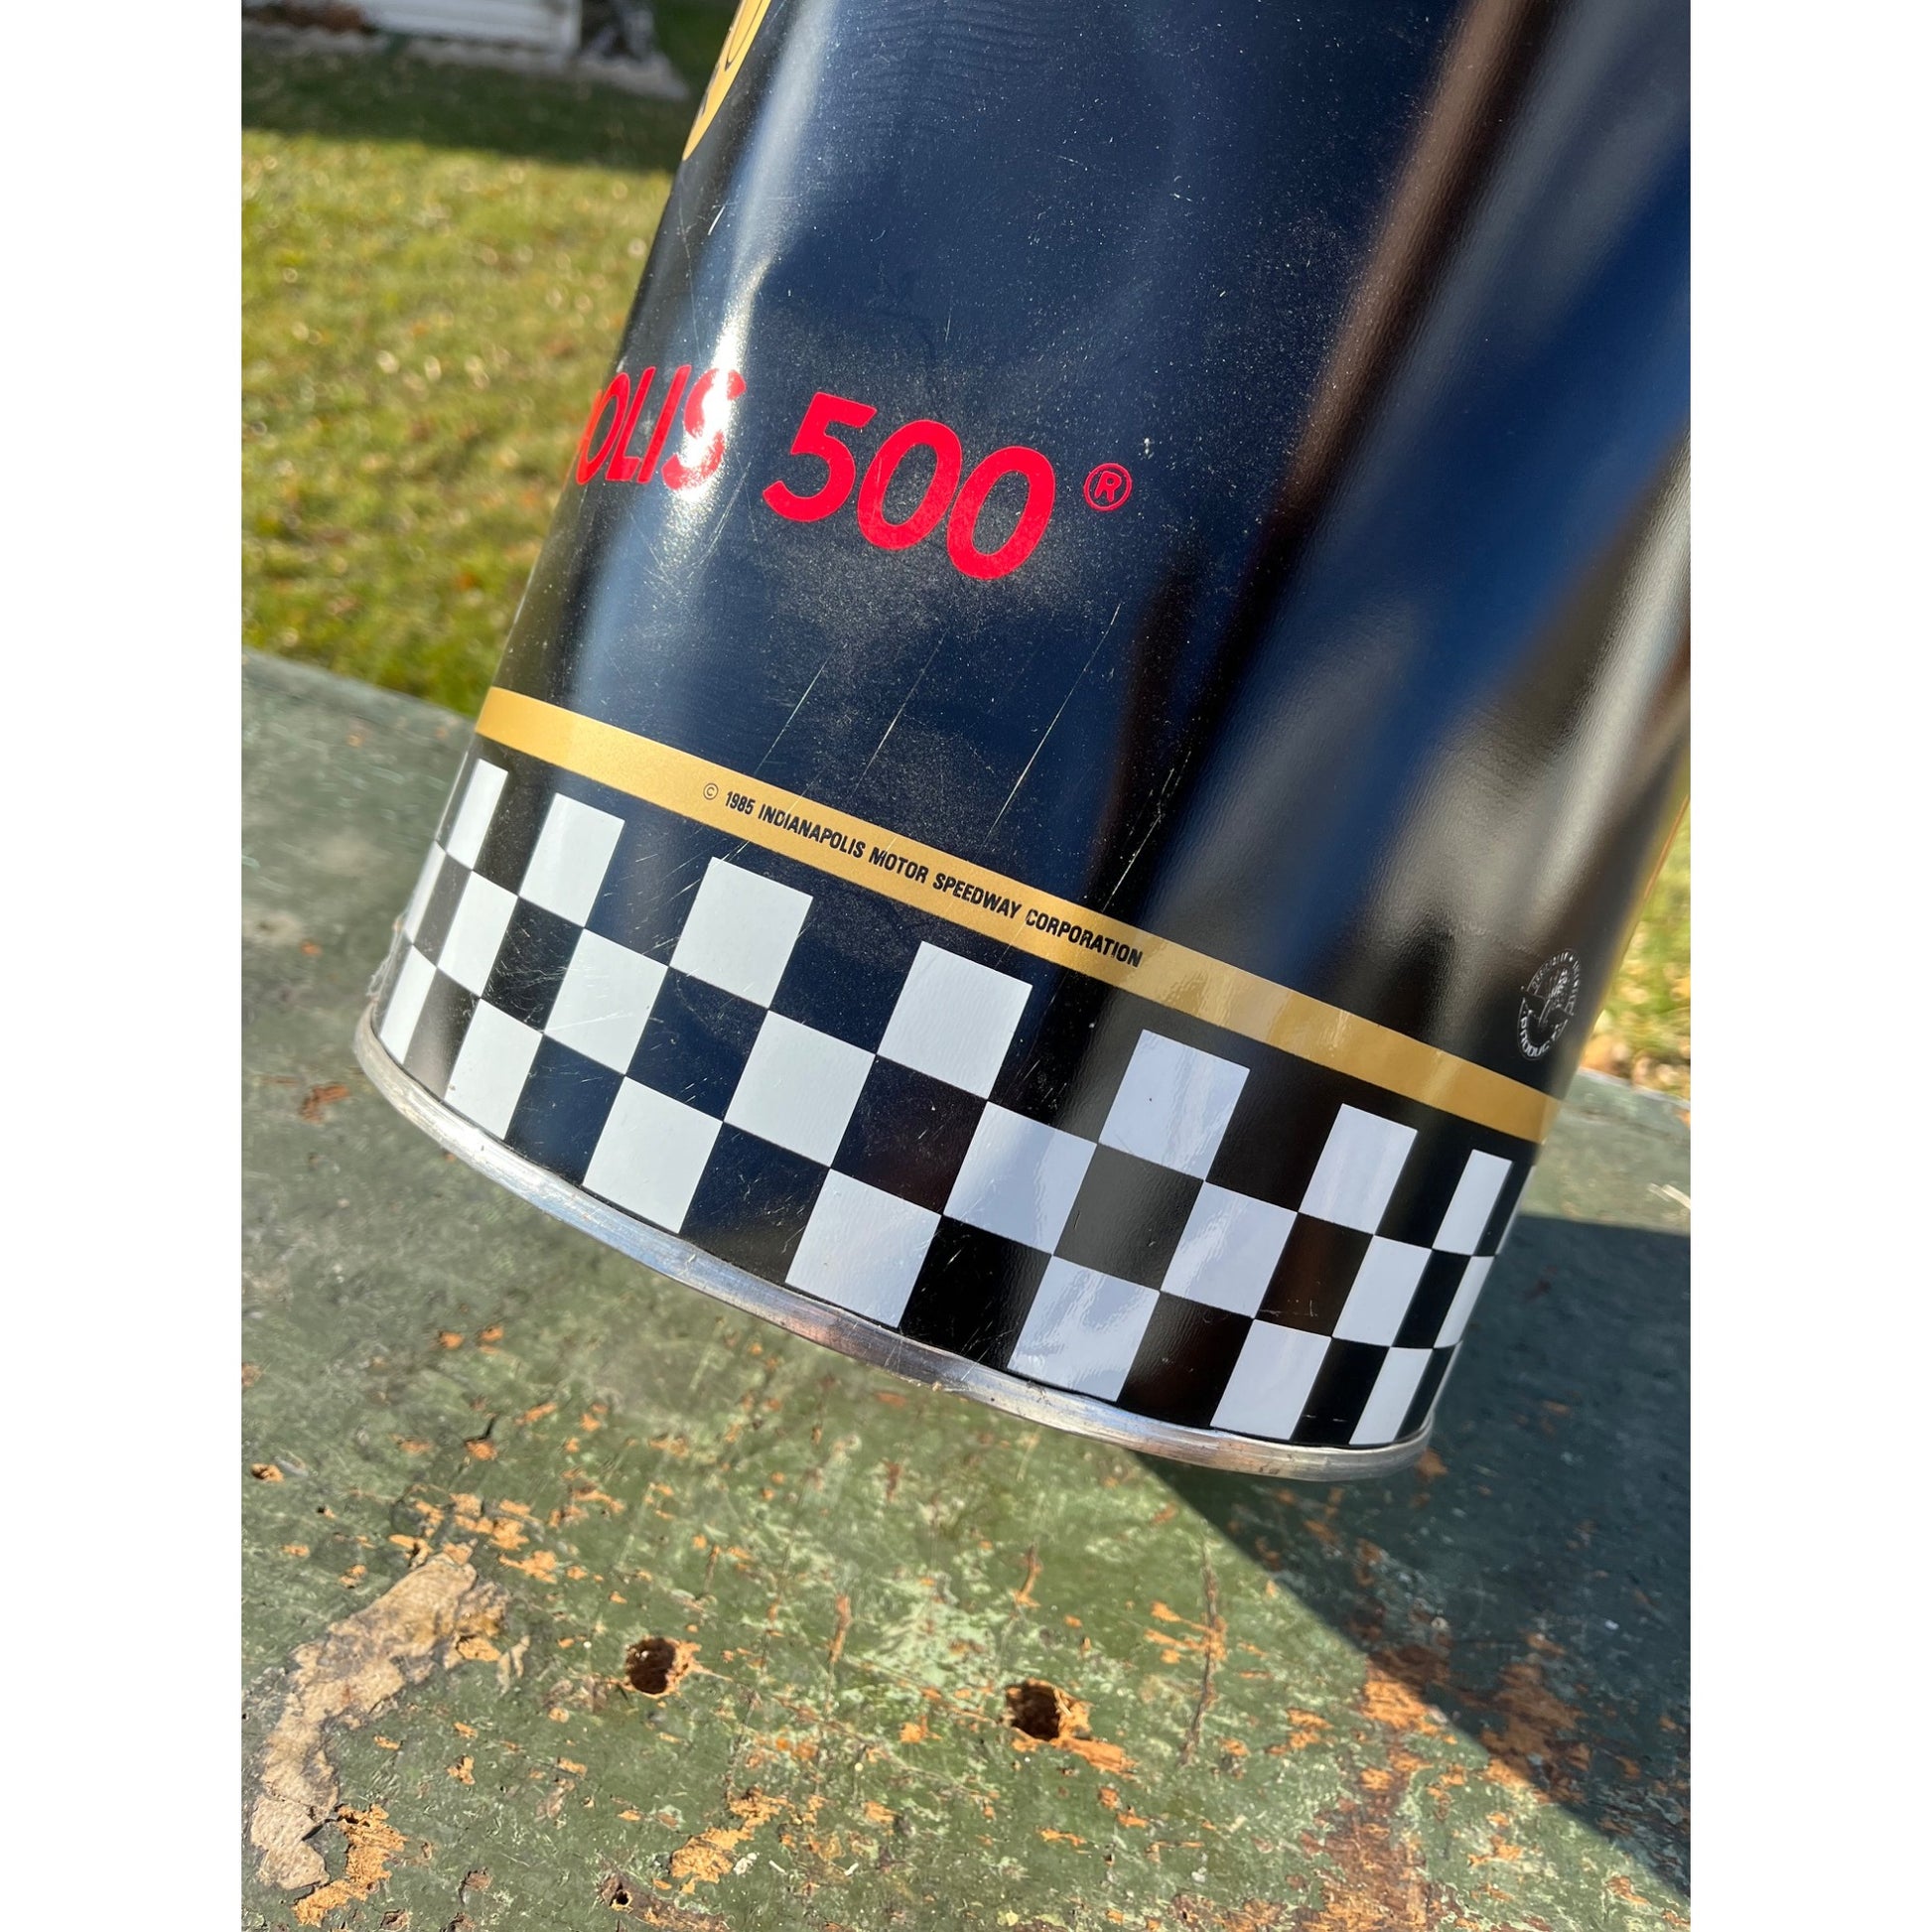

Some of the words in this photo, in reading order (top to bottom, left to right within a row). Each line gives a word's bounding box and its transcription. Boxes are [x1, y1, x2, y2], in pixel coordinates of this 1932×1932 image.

[762, 392, 1055, 581] 500
[725, 791, 756, 815] 1985
[758, 803, 866, 859] INDIANAPOLIS
[869, 846, 929, 884] MOTOR
[933, 873, 1022, 919] SPEEDWAY
[1026, 908, 1144, 968] CORPORATION
